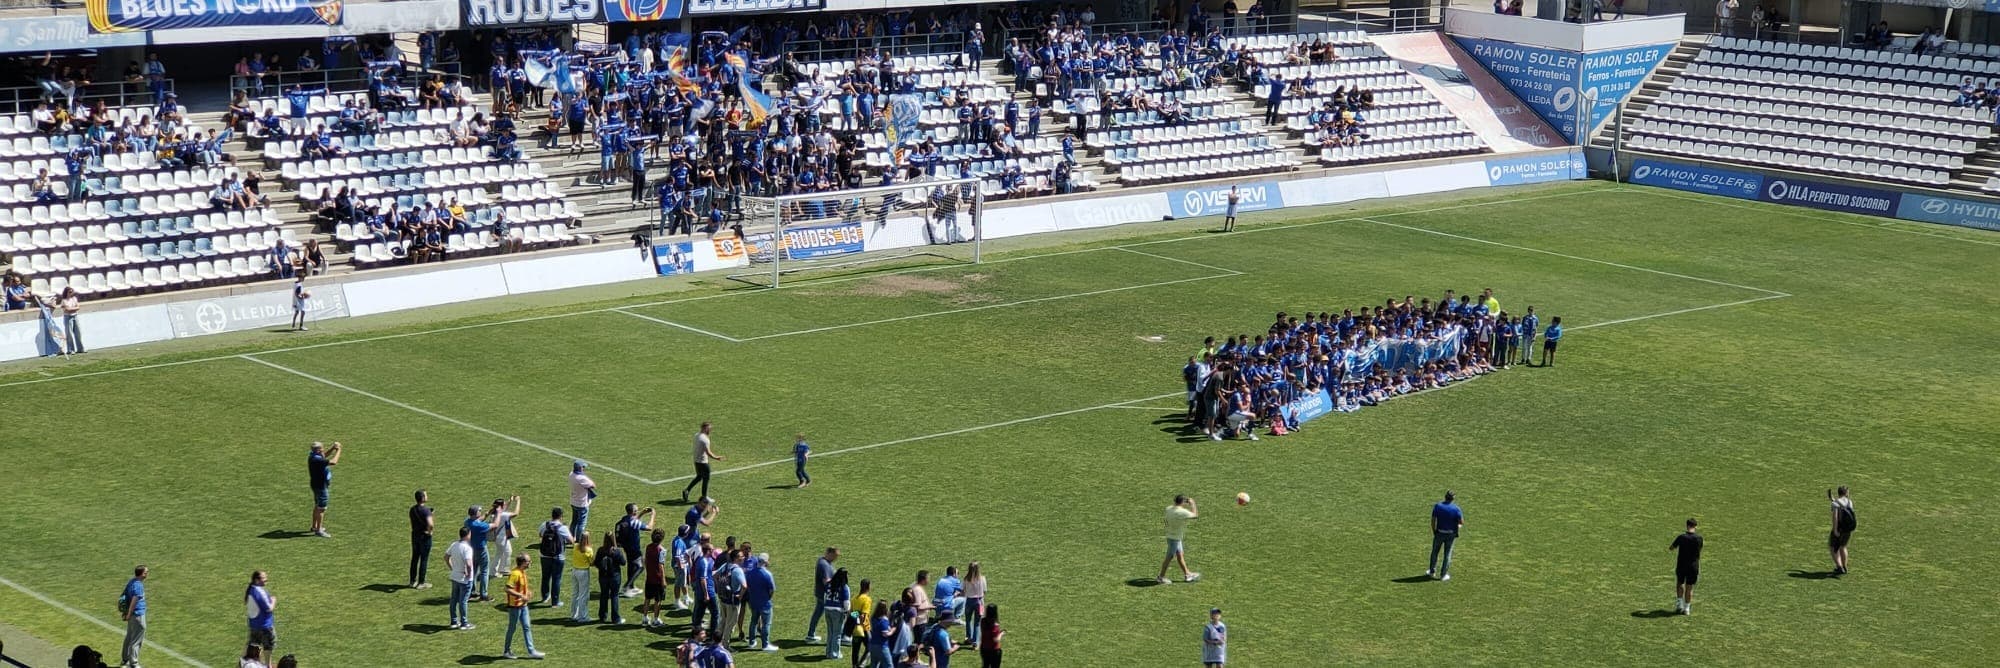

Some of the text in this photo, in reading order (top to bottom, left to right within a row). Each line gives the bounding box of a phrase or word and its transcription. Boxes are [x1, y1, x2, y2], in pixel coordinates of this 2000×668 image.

[1474, 44, 1577, 69] RAMON SOLER
[1585, 50, 1659, 70] RAMON SOLER
[1491, 61, 1520, 73] Ferros
[1527, 66, 1571, 81] Ferreteria
[1588, 72, 1610, 82] Ferros
[1615, 66, 1646, 78] Ferreteria
[1528, 94, 1551, 105] LLEIDA
[1503, 160, 1572, 174] RAMON SOLER
[1651, 167, 1744, 187] RAMON SOLER
[1202, 186, 1267, 207] VISRVI
[1788, 185, 1890, 211] HLA PERPETUO SOCORRO
[1951, 202, 2000, 220] HYUN
[791, 229, 836, 249] RUDES
[231, 298, 325, 321] LLEIDA.OM
